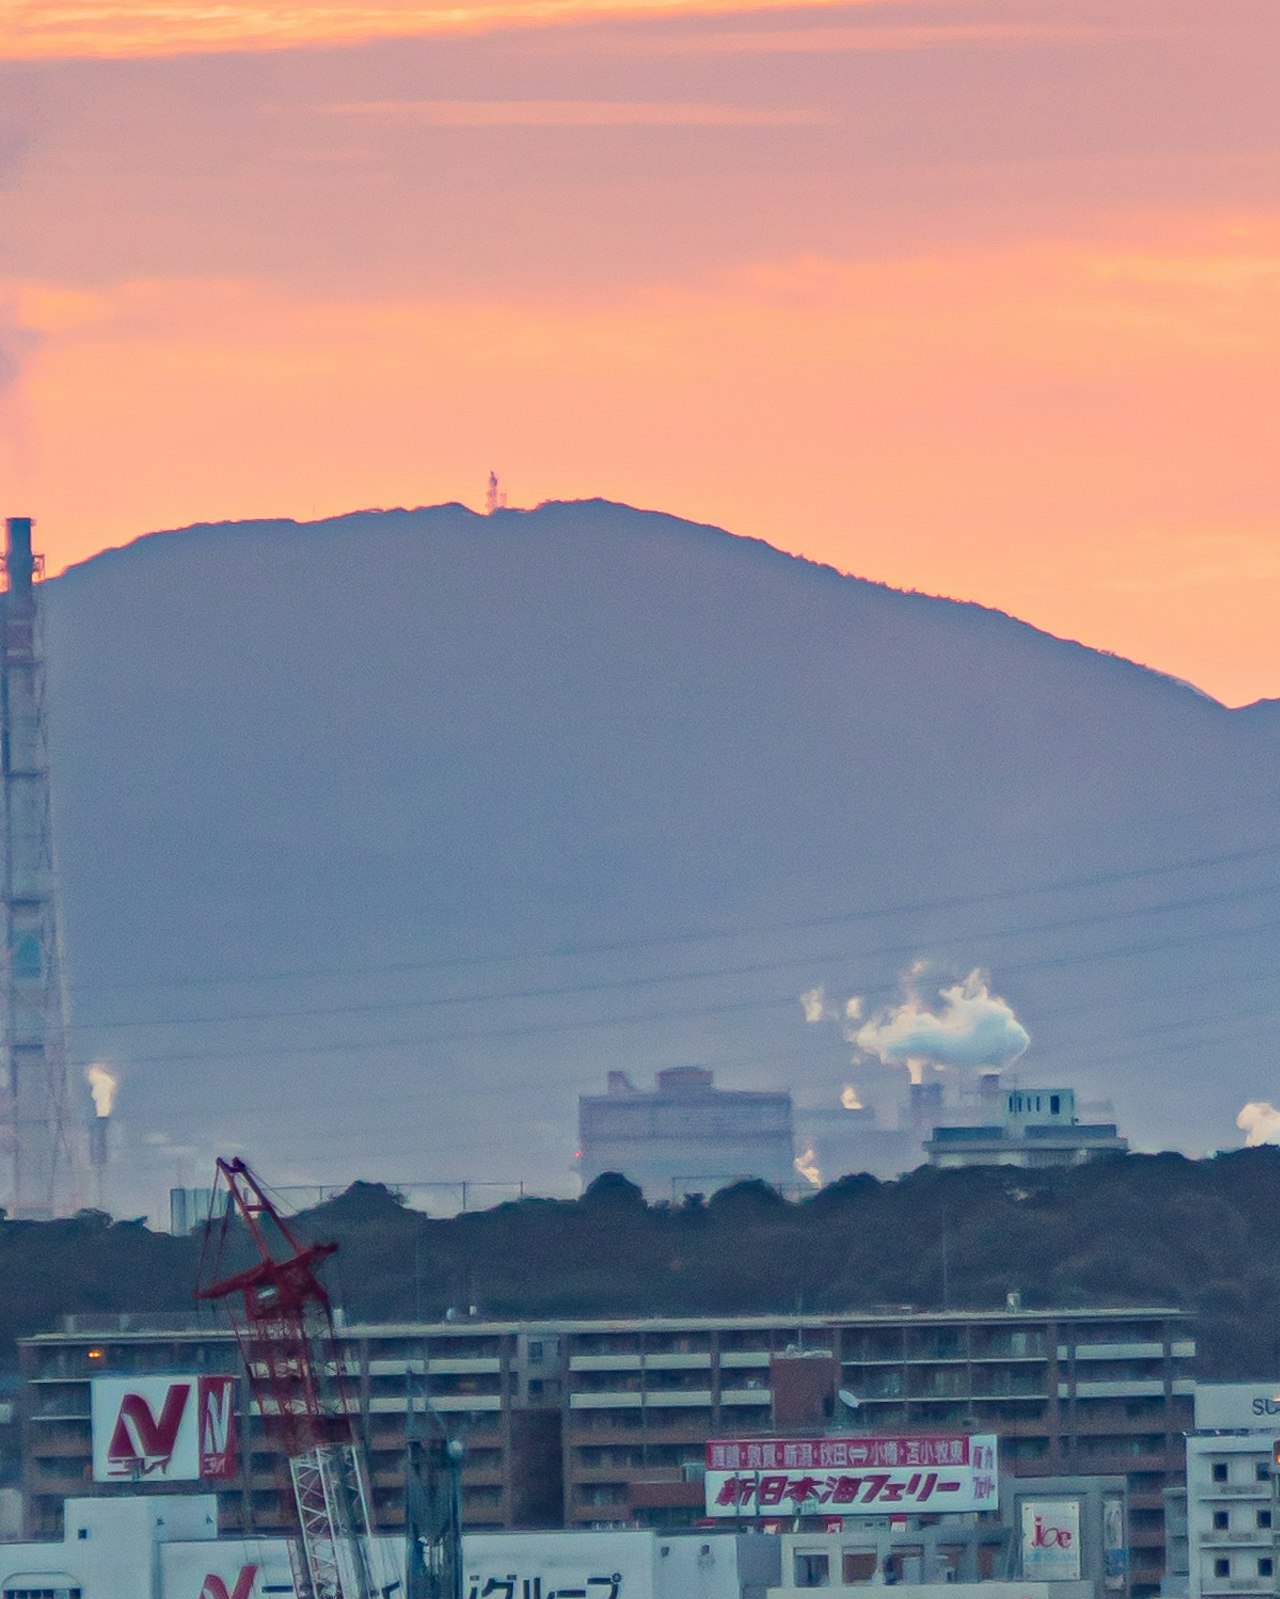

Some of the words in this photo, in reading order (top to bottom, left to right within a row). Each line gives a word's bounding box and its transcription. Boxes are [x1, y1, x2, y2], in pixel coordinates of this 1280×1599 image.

[715, 1472, 961, 1507] 新日本海フェリー
